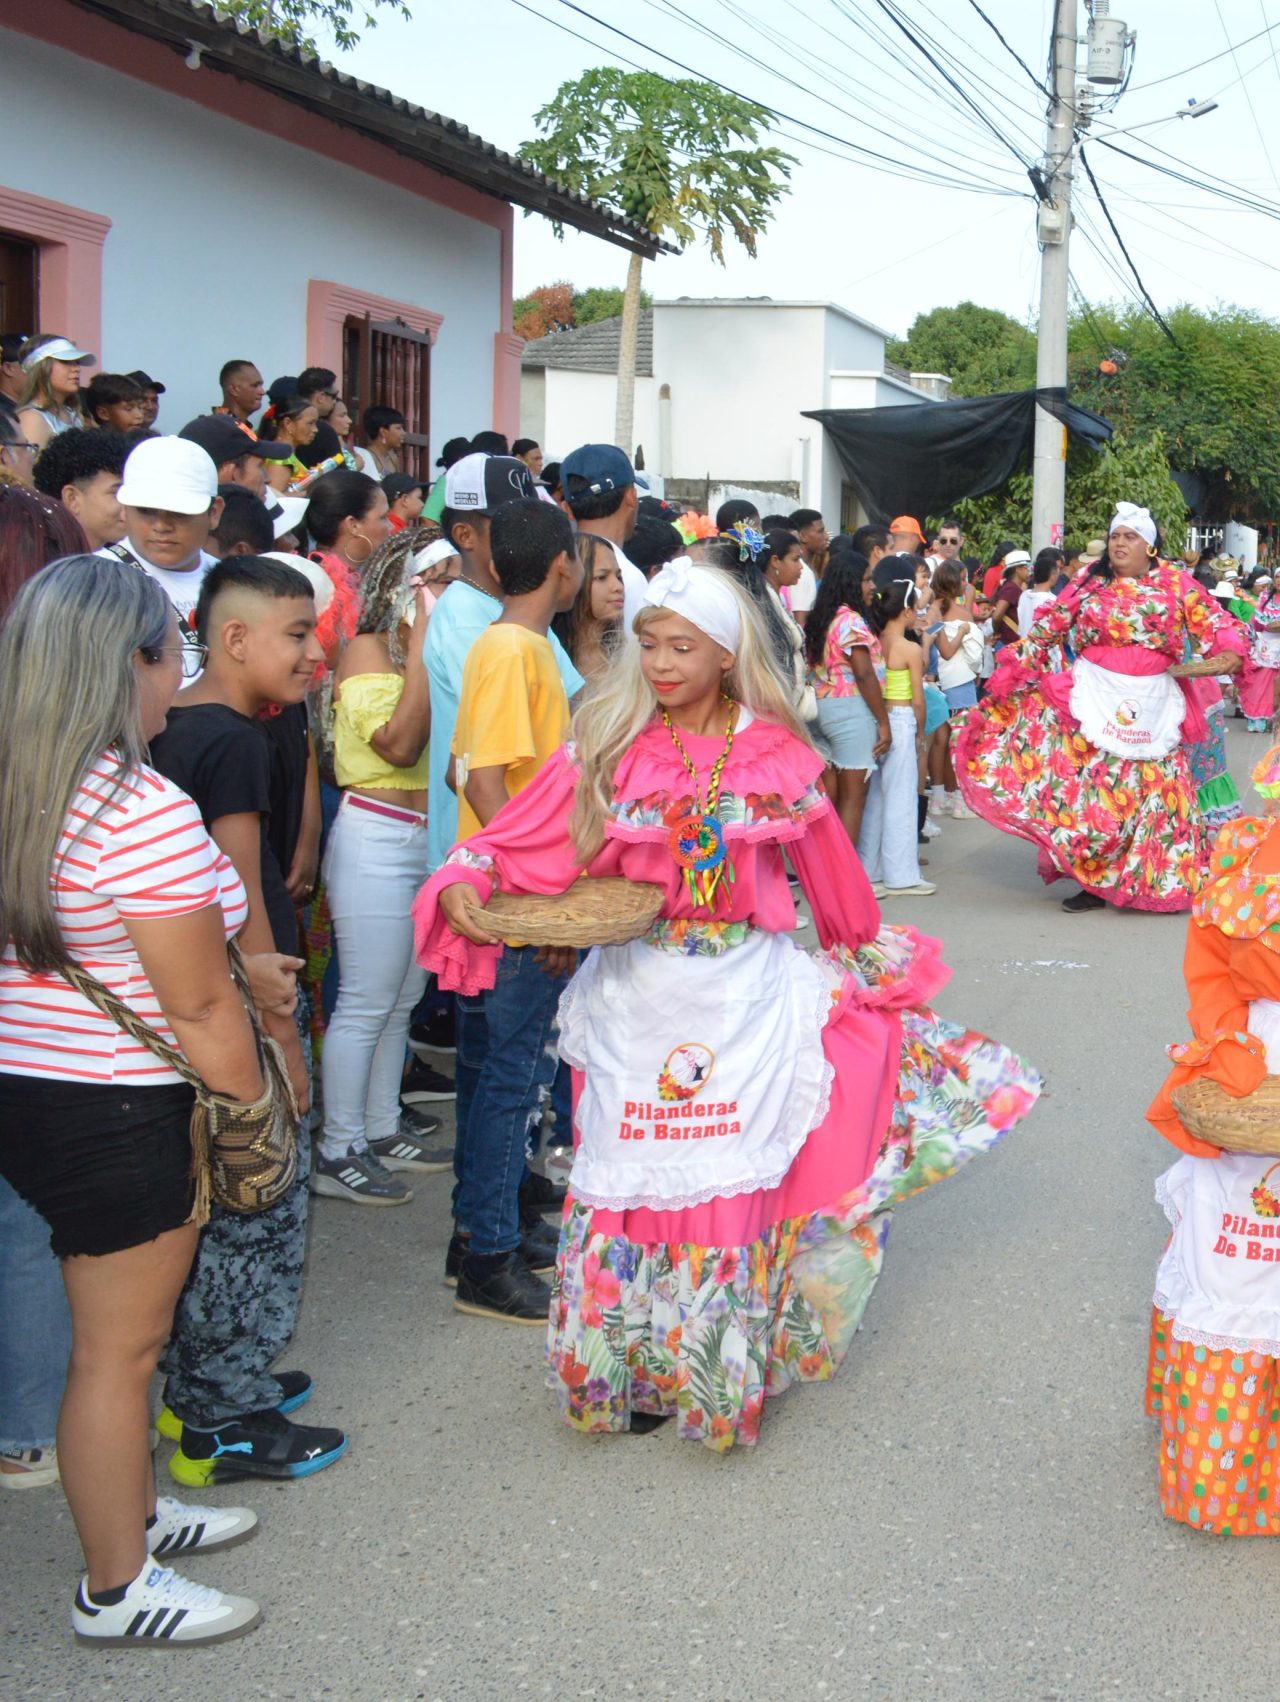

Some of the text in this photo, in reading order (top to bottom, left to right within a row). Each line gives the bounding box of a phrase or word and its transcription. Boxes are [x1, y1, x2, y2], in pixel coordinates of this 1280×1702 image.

[624, 1101, 738, 1120] Pilanderas
[619, 1120, 741, 1141] De Baranoa
[1213, 1234, 1237, 1258] De
